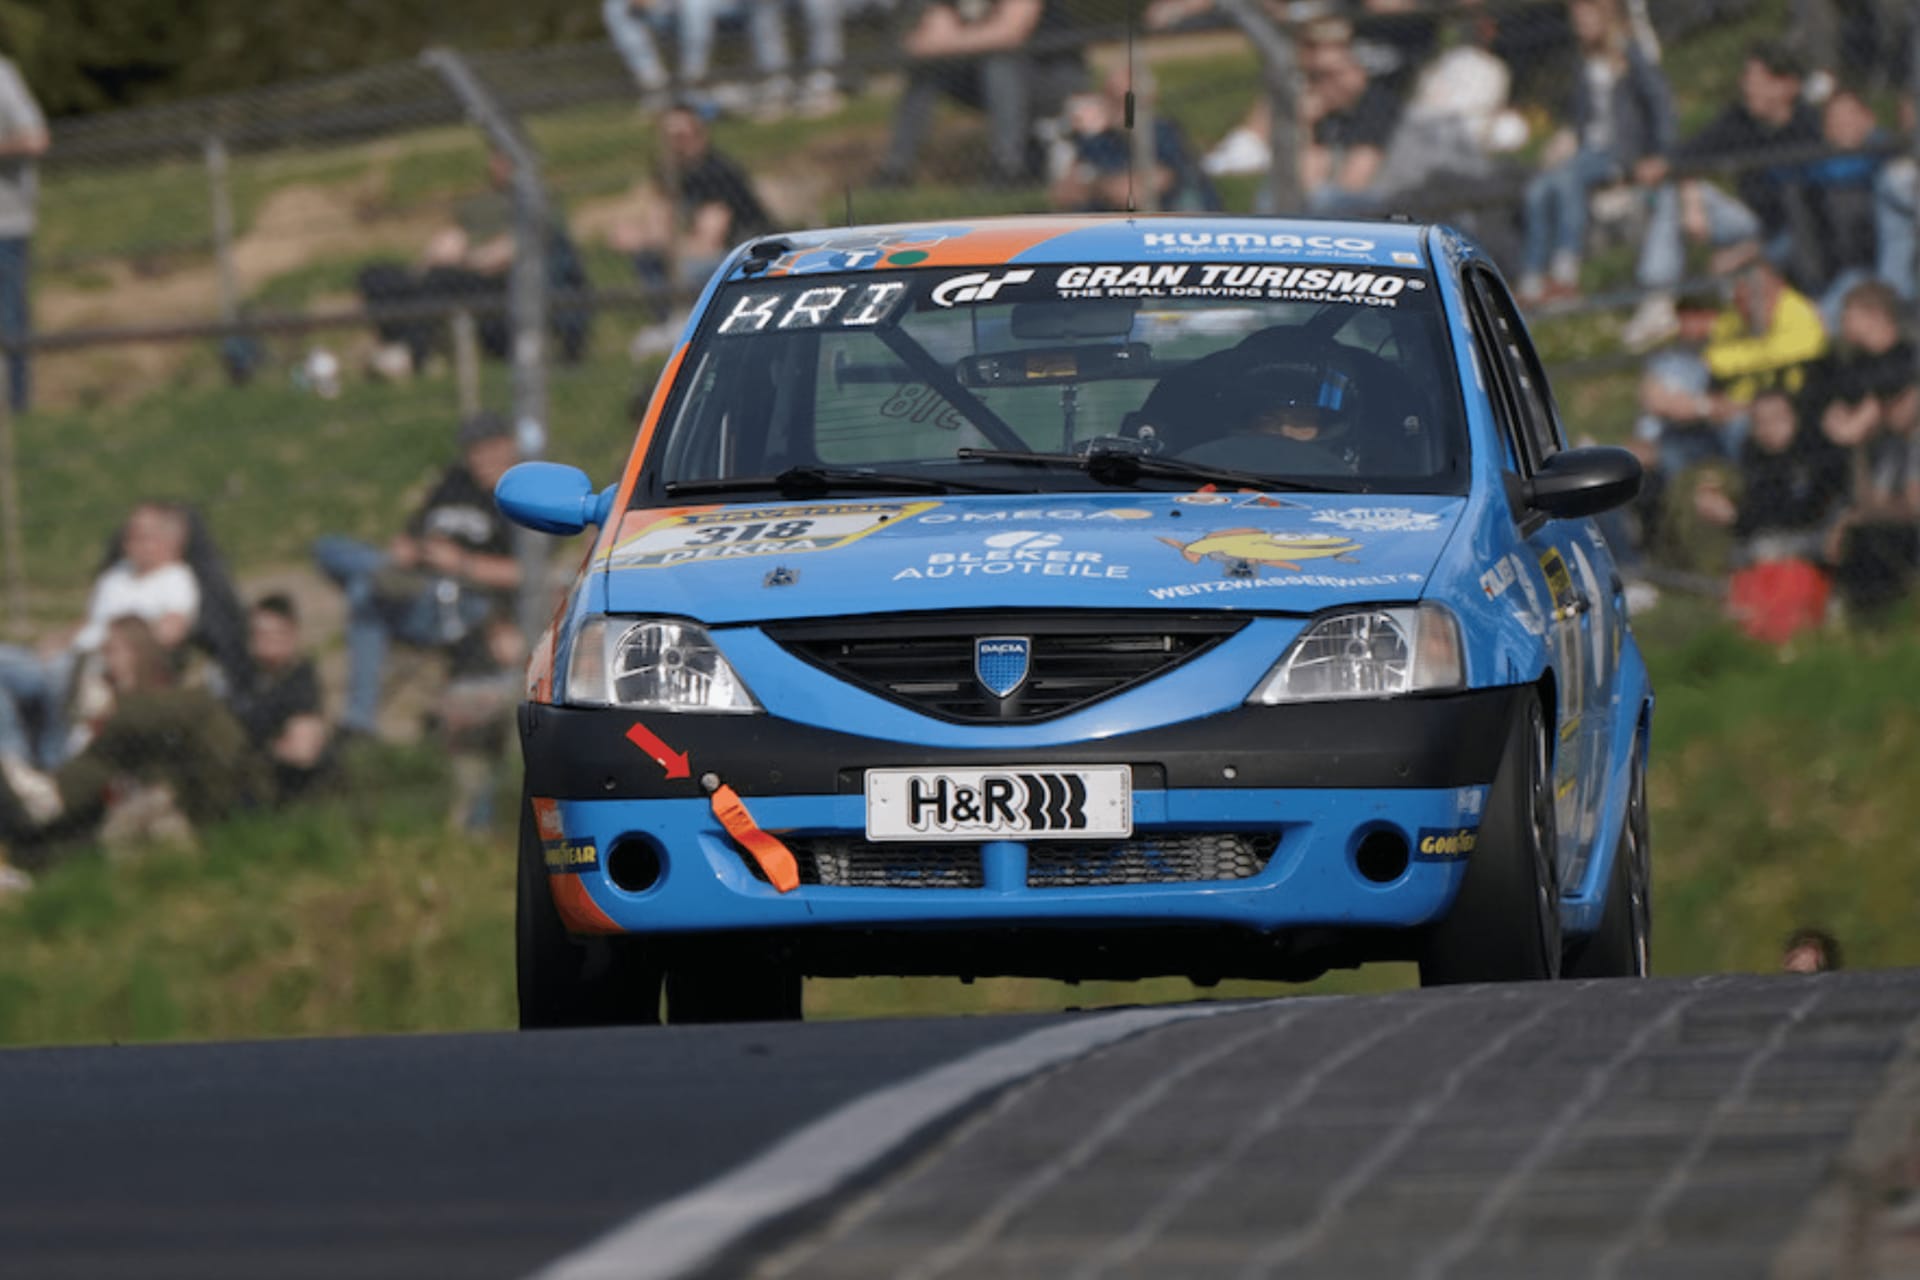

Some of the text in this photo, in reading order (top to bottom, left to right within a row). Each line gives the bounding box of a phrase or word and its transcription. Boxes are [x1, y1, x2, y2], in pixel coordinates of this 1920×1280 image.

[1056, 265, 1189, 289] GRAN
[1058, 286, 1397, 308] THE REAL DRIVING SIMULATOR
[918, 509, 1125, 523] OMEGA
[687, 520, 815, 546] 318
[660, 539, 817, 565] DEKRA
[928, 550, 1104, 565] BLEKER
[892, 562, 1131, 581] AUTOTEILE
[1148, 573, 1398, 600] WEITZWASSERWELT
[981, 643, 1025, 654] DACIA
[909, 777, 1018, 825] H&R
